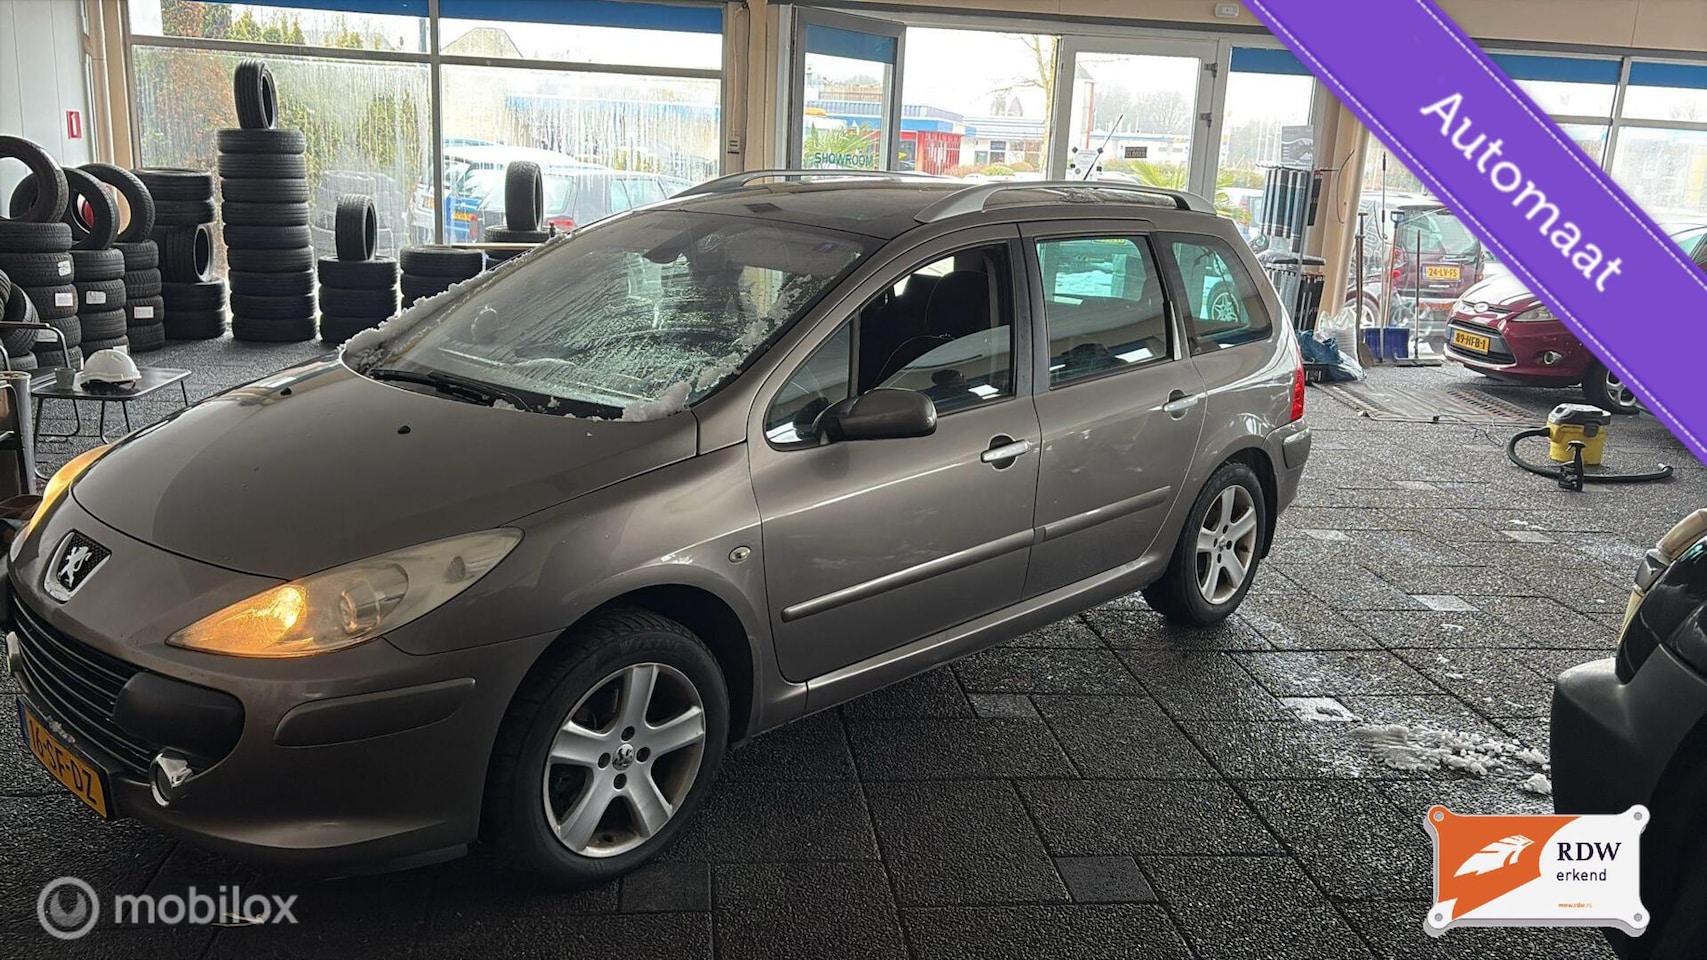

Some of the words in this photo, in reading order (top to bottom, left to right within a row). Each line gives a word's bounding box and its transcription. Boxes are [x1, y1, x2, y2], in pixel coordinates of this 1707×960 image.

[814, 152, 874, 168] SHOWROOM
[1428, 266, 1458, 277] 24-LV-FS
[1455, 332, 1486, 349] 89-HFB-1
[29, 719, 97, 805] 16-SF-DZ
